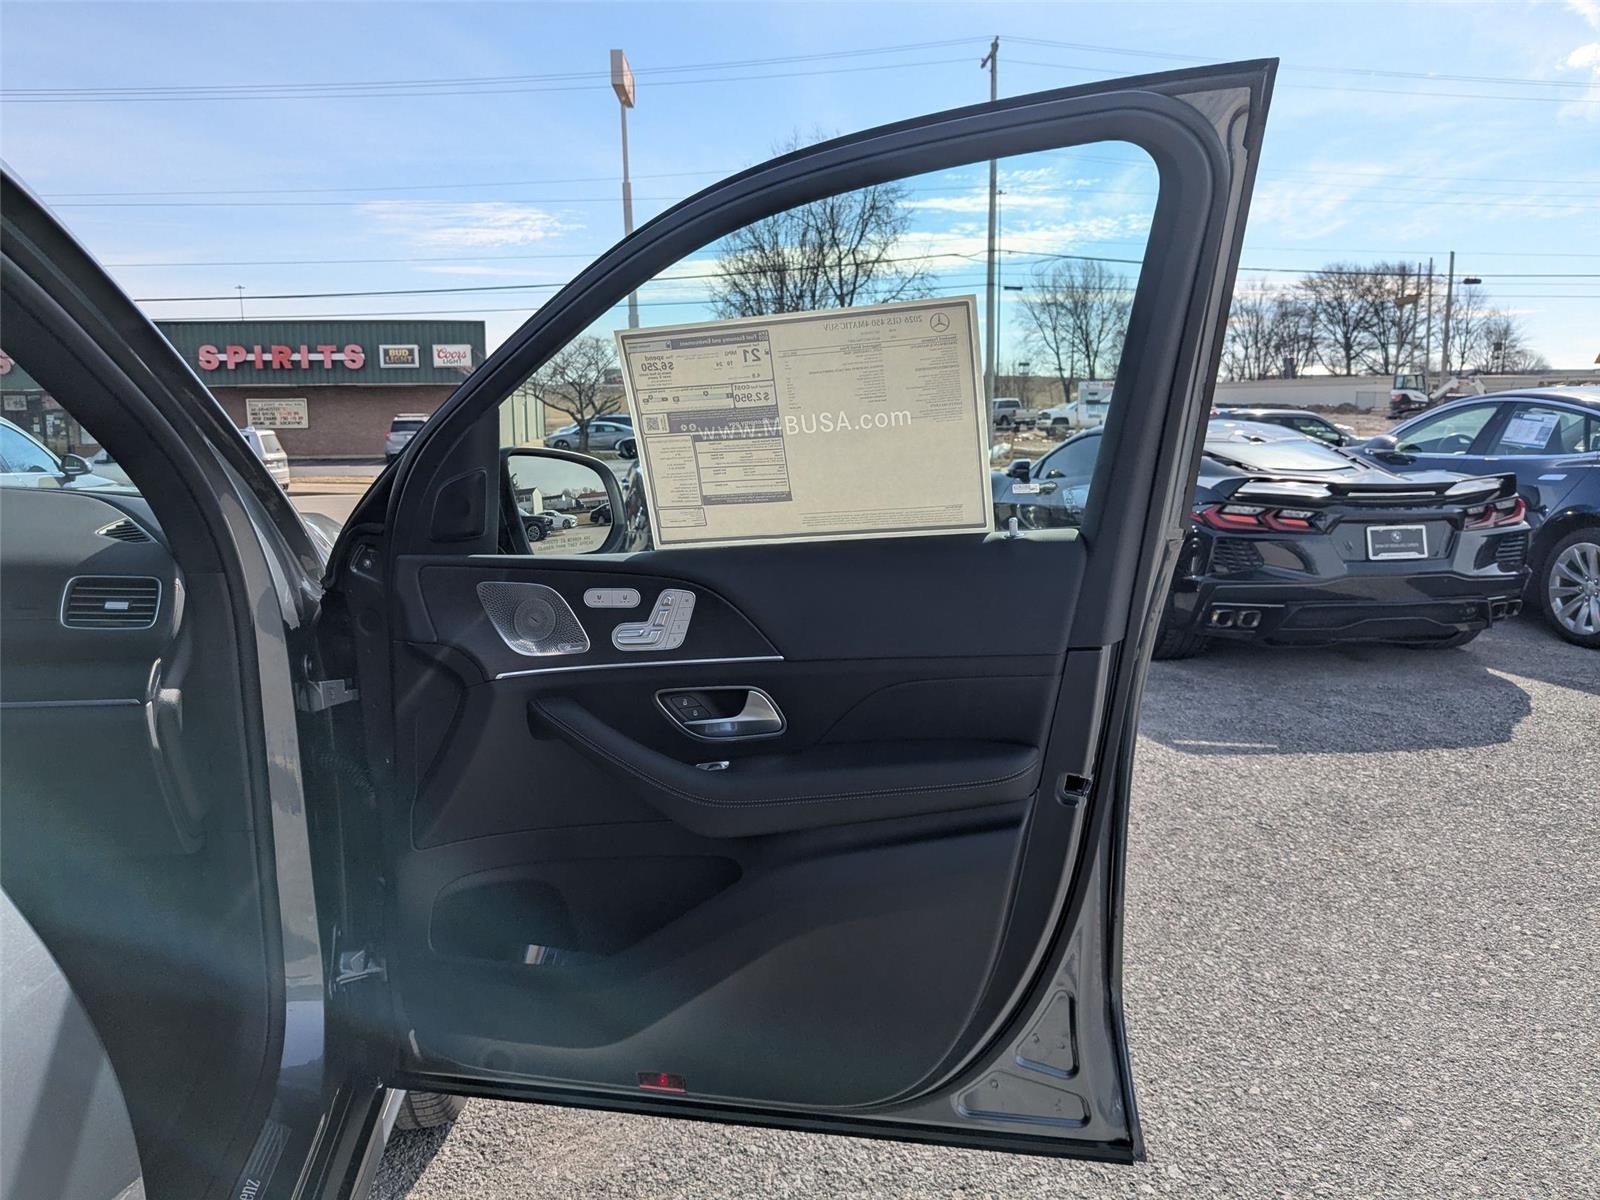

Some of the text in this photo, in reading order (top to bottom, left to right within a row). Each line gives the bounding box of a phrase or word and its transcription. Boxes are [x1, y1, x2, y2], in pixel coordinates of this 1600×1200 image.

[198, 344, 365, 371] SPIRITS
[388, 348, 409, 357] BUD
[436, 347, 467, 359] Coors
[699, 409, 912, 441] www.MBUSA.com
